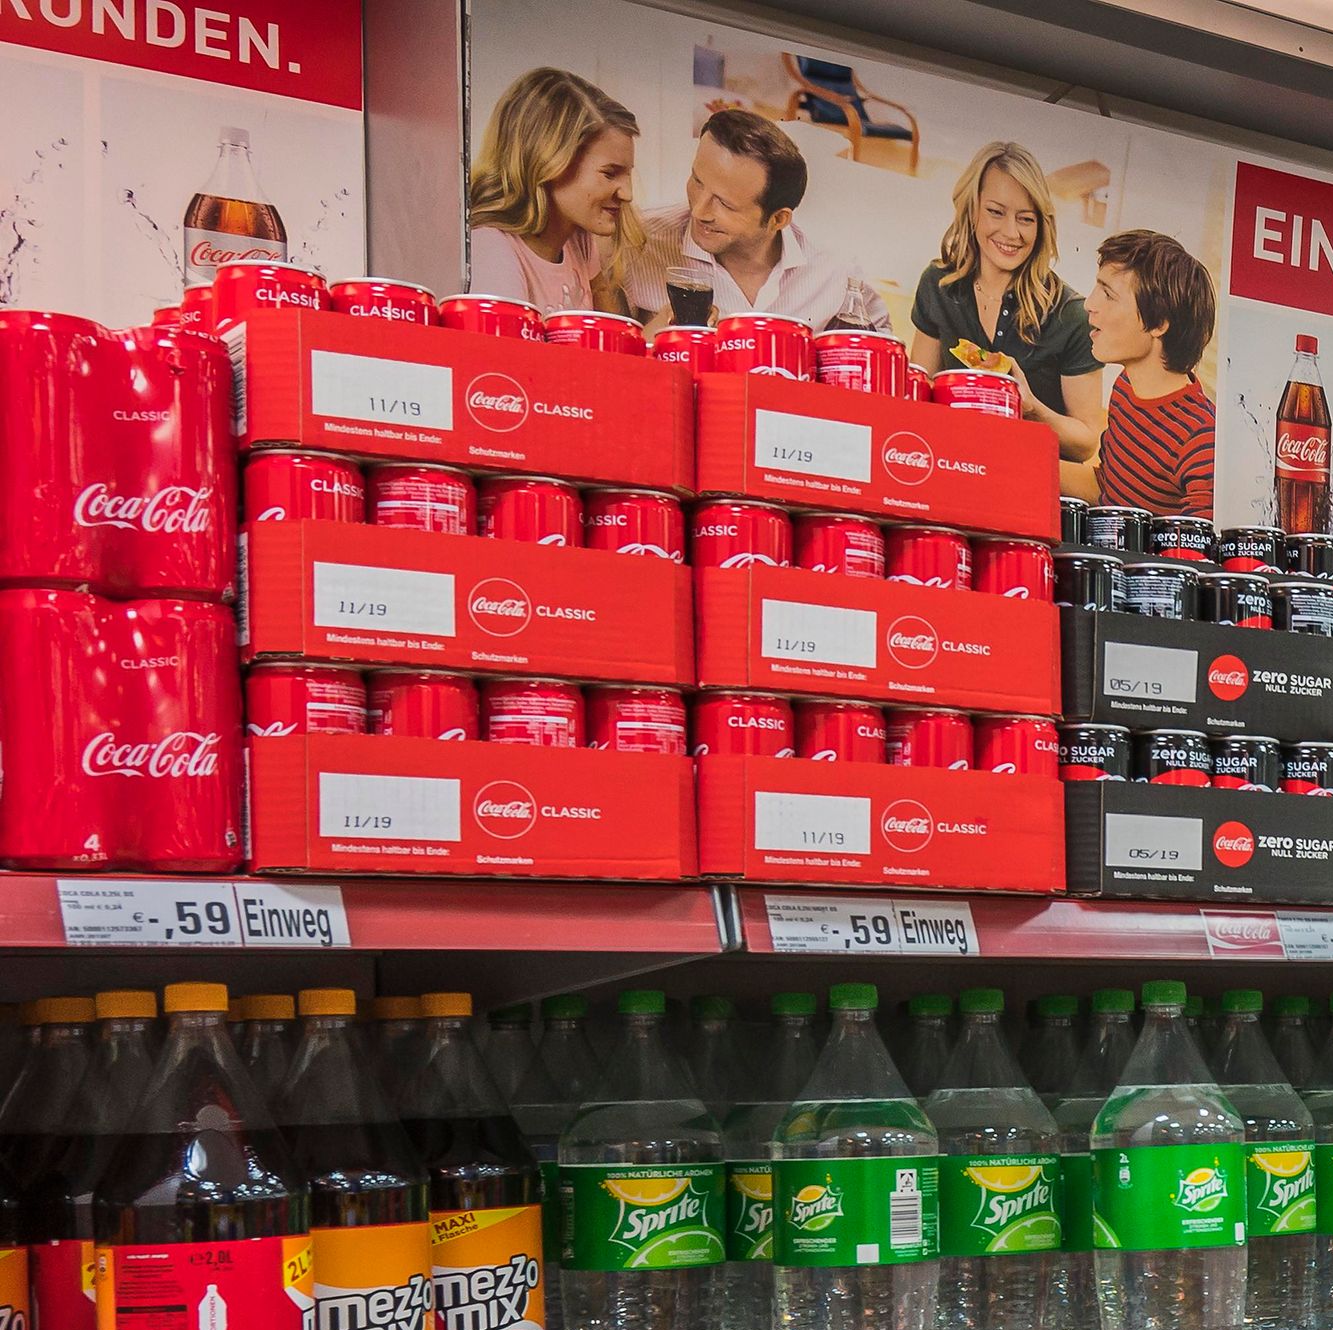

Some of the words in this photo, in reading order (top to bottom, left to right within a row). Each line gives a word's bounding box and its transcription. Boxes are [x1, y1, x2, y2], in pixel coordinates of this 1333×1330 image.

[0, 0, 300, 74] UNDEN.
[350, 305, 415, 322] CLASSIC
[370, 397, 421, 416] 11/19
[534, 403, 593, 420] CLASSIC
[113, 409, 170, 422] CLASSIC
[772, 447, 812, 463] 11/19
[938, 459, 986, 476] CLASSIC
[73, 483, 212, 534] Coca-Cola
[1180, 534, 1211, 546] SUGAR
[339, 601, 387, 616] 11/19
[536, 606, 596, 621] CLASSIC
[776, 638, 816, 652] 11/19
[942, 642, 990, 655] CLASSIC
[120, 656, 179, 670] CLASSIC
[1110, 678, 1162, 695] 05/19
[1253, 670, 1287, 684] zero
[1290, 674, 1331, 689] SUGAR
[1266, 684, 1286, 694] NULL
[1290, 686, 1322, 696] ZUCKER
[728, 716, 785, 730] CLASSIC
[82, 732, 219, 778] Coca-Cola
[541, 807, 601, 819] CLASSIC
[344, 816, 392, 828] 11/19
[938, 823, 986, 834] CLASSIC
[802, 831, 844, 845] 11/19
[243, 899, 332, 946] Einweg
[900, 910, 967, 955] Einweg
[793, 1194, 837, 1226] Sprite
[434, 1212, 475, 1235] MAXI
[621, 1198, 703, 1241] Sprite
[432, 1254, 539, 1305] mezzo
